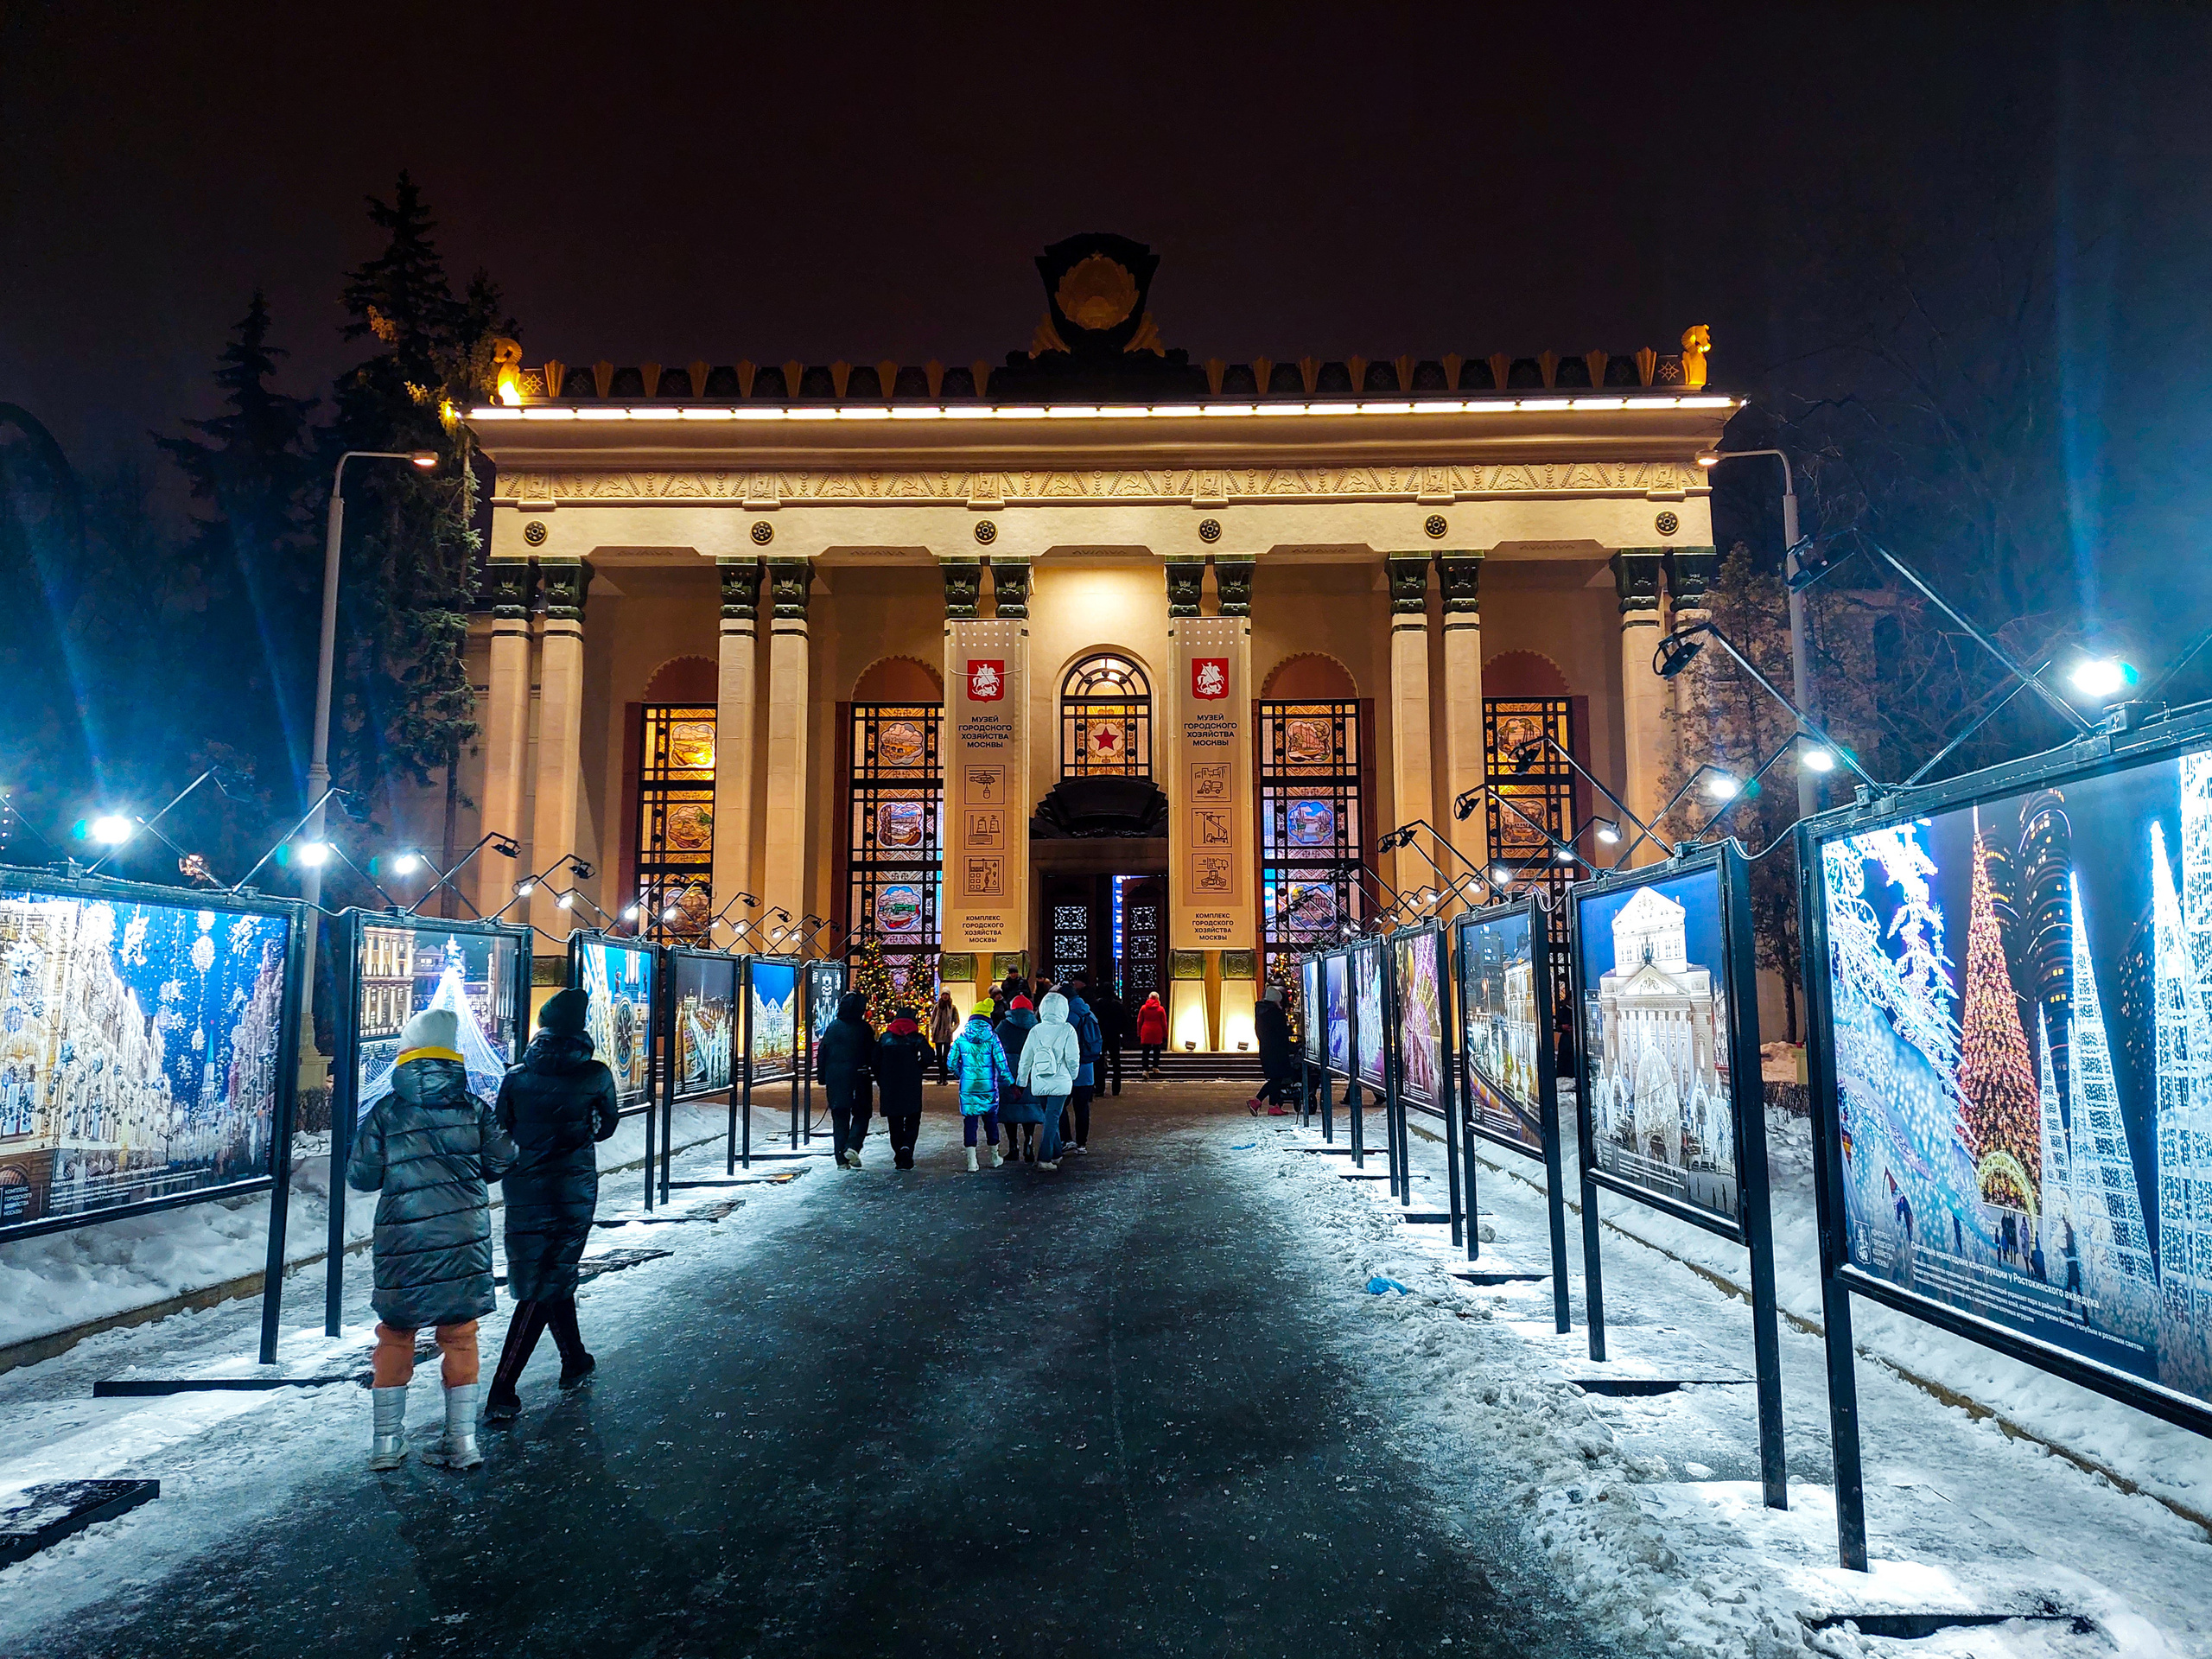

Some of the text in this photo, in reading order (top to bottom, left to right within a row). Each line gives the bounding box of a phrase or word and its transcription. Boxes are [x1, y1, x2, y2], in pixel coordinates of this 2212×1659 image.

[1910, 1240, 2099, 1308] Световые новогодние конструкции у Ростокинского акведука
